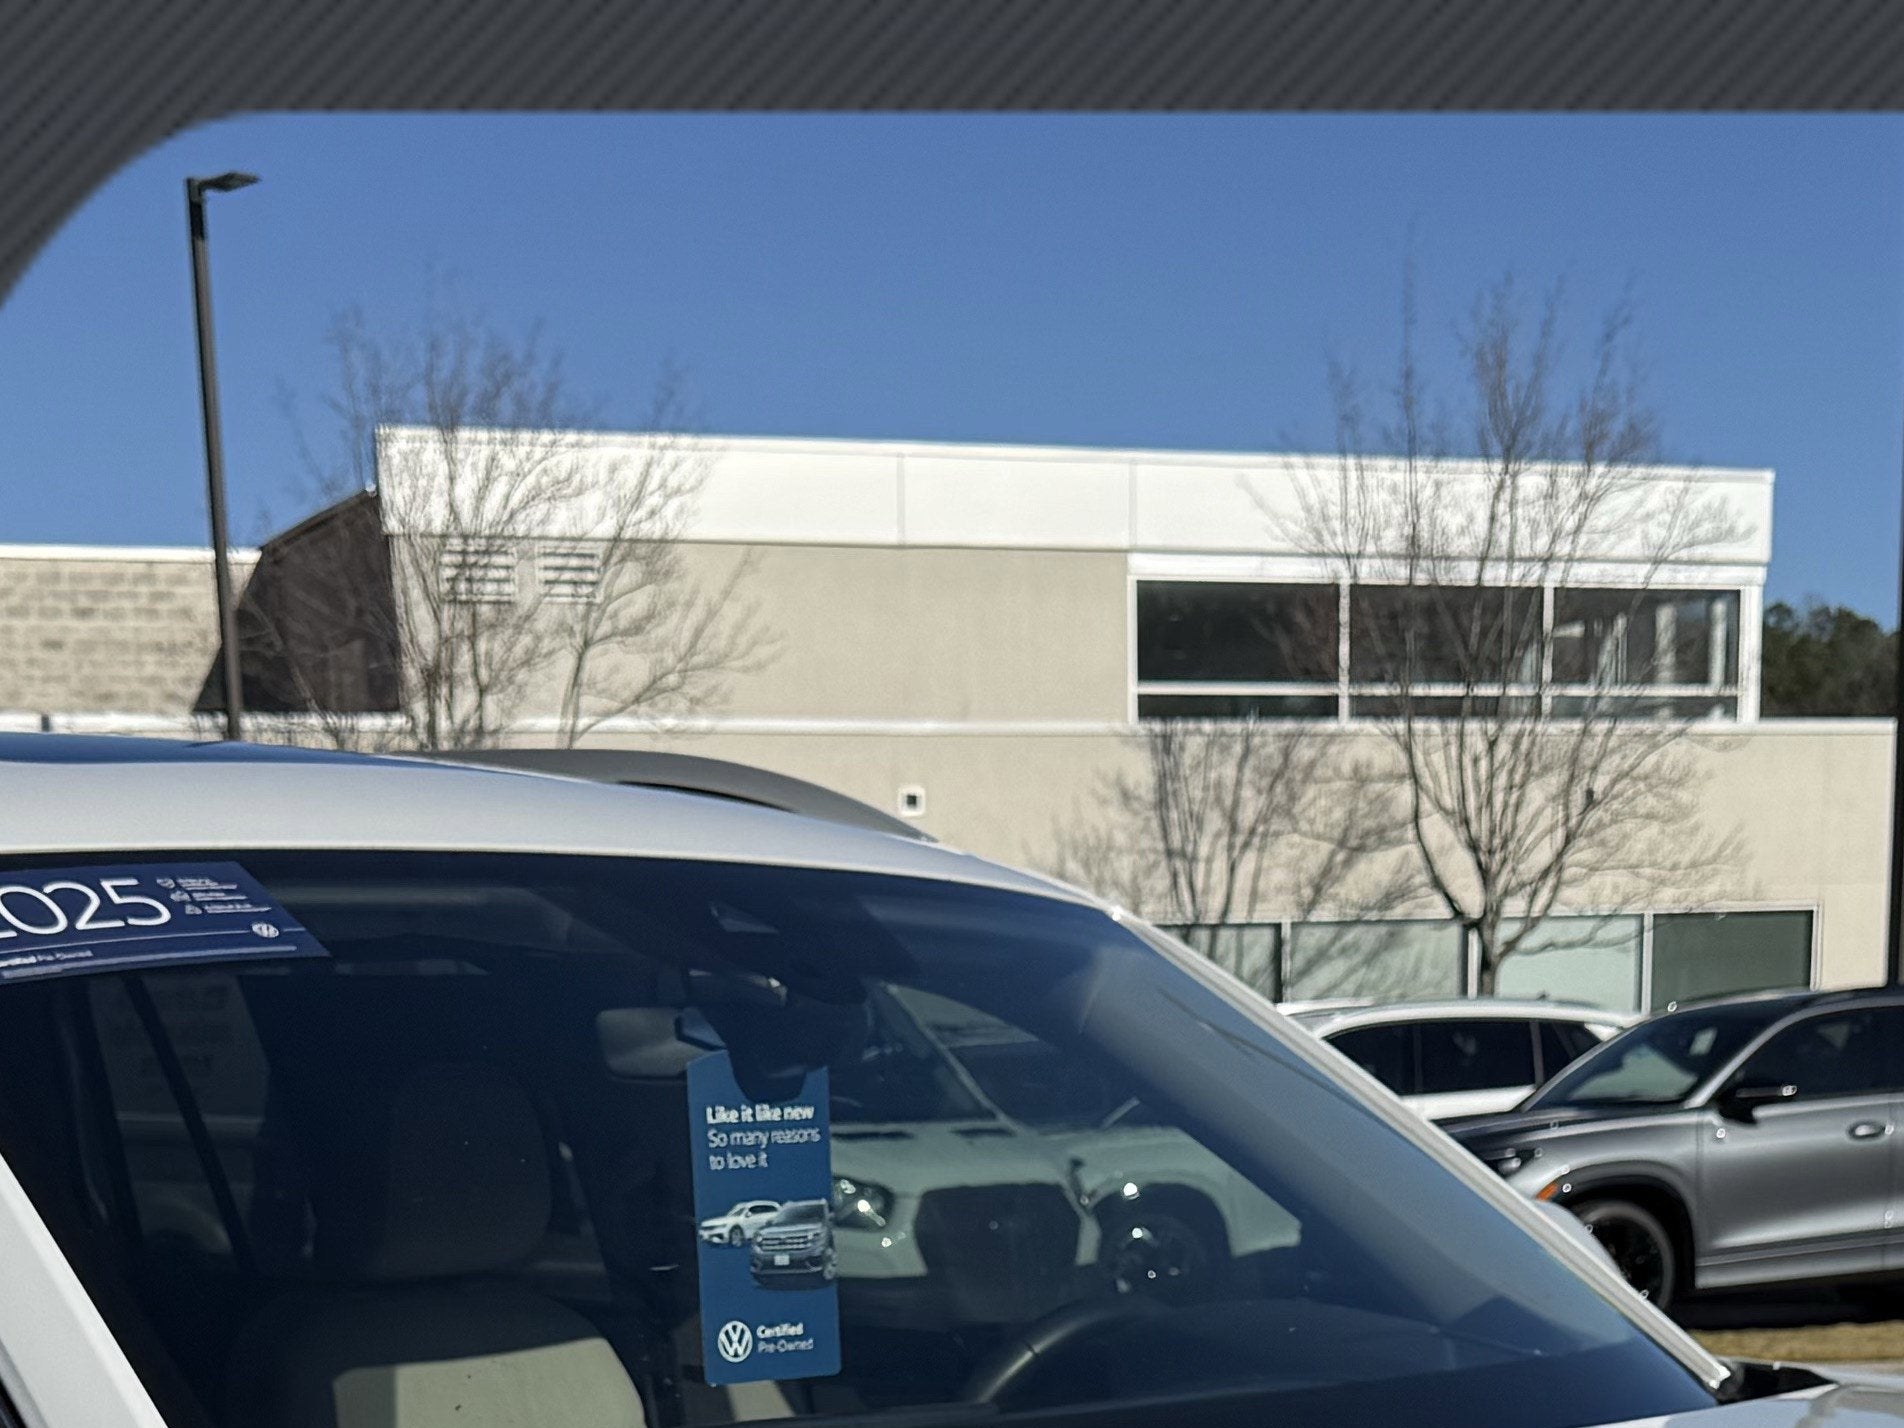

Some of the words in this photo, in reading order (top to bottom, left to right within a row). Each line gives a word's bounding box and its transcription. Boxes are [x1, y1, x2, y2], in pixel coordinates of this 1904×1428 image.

[705, 1105, 739, 1124] Like
[740, 1104, 754, 1123] it
[755, 1103, 782, 1122] like
[783, 1106, 815, 1120] new
[707, 1128, 728, 1148] So
[729, 1130, 769, 1149] many
[770, 1127, 822, 1144] reasons
[709, 1154, 725, 1171] to
[726, 1151, 757, 1169] love
[758, 1150, 769, 1168] it
[756, 1322, 804, 1339] Certified
